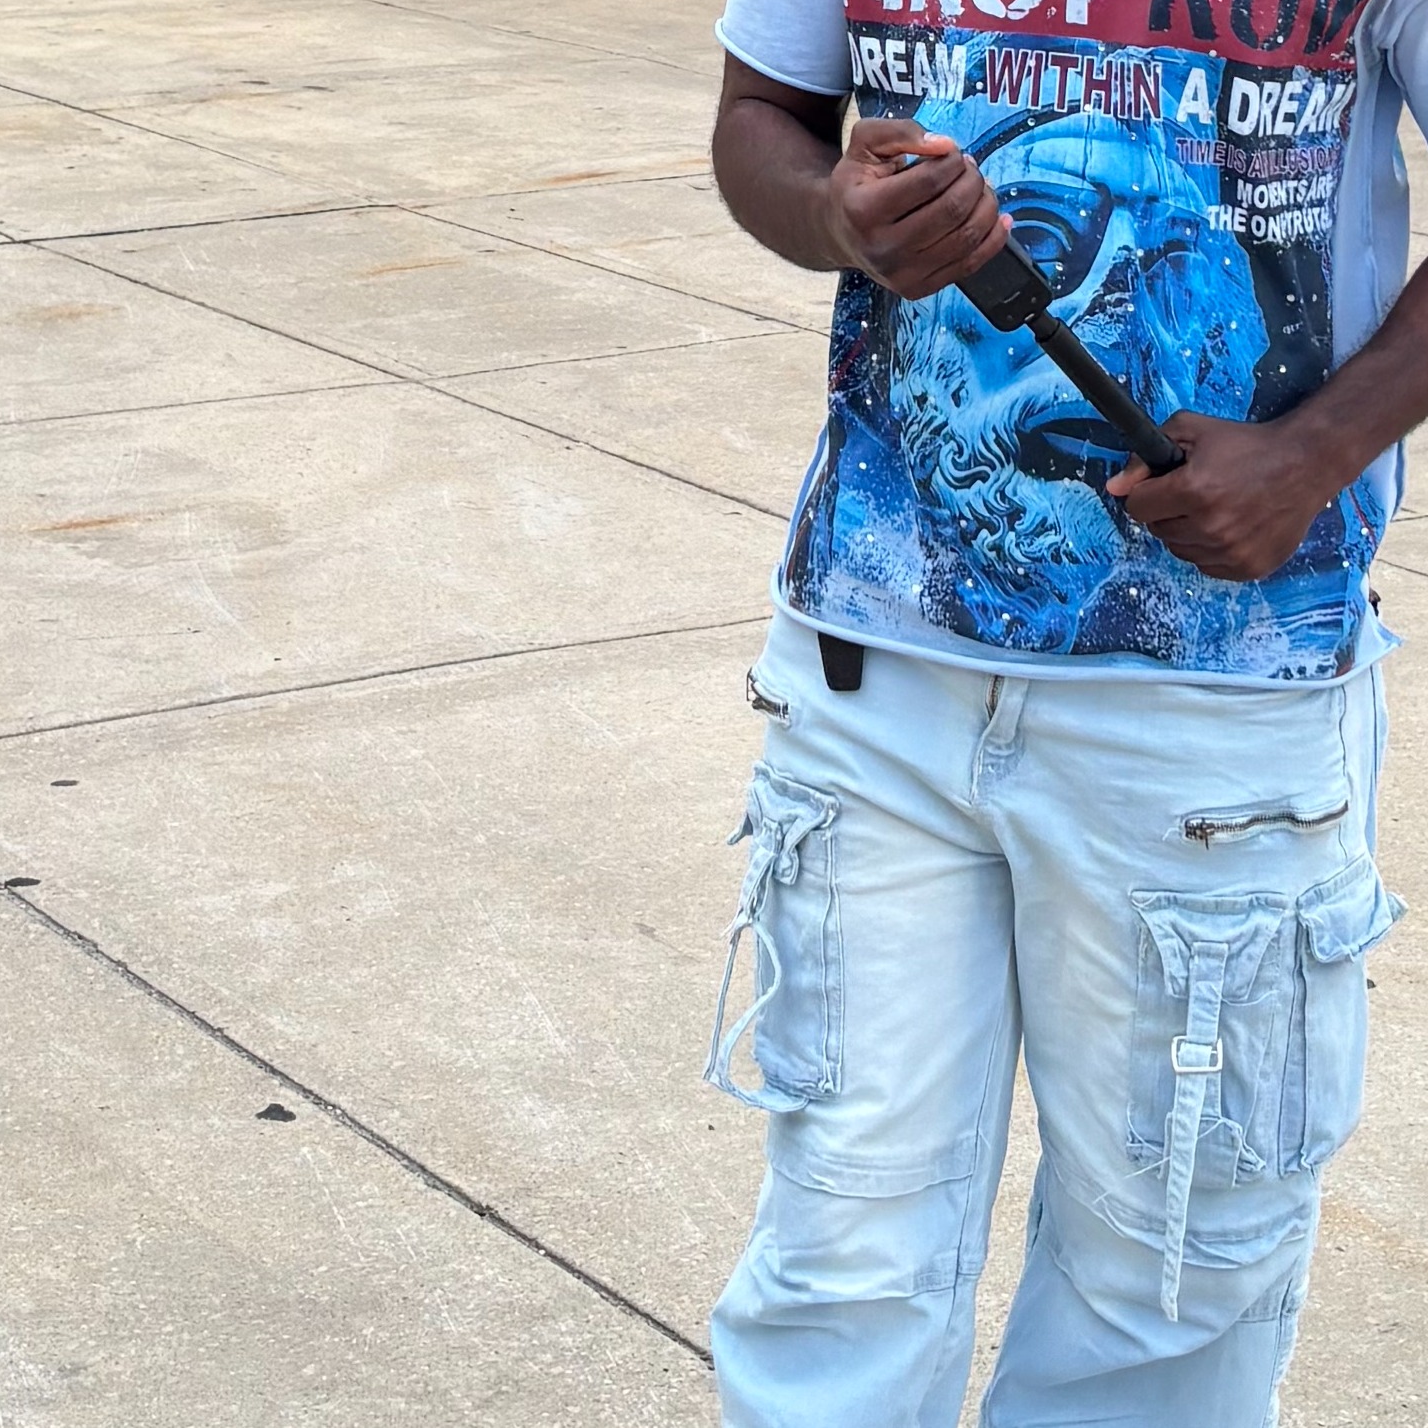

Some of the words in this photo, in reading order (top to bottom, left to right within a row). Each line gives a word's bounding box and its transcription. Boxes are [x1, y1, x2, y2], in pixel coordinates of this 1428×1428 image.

[850, 33, 966, 103] DREAM
[986, 45, 1163, 120] WITHIN
[1177, 67, 1213, 124] A
[1228, 76, 1357, 138] DREAM
[1176, 137, 1227, 167] TIME
[1237, 177, 1308, 209] MOENTS
[1207, 204, 1249, 233] THE
